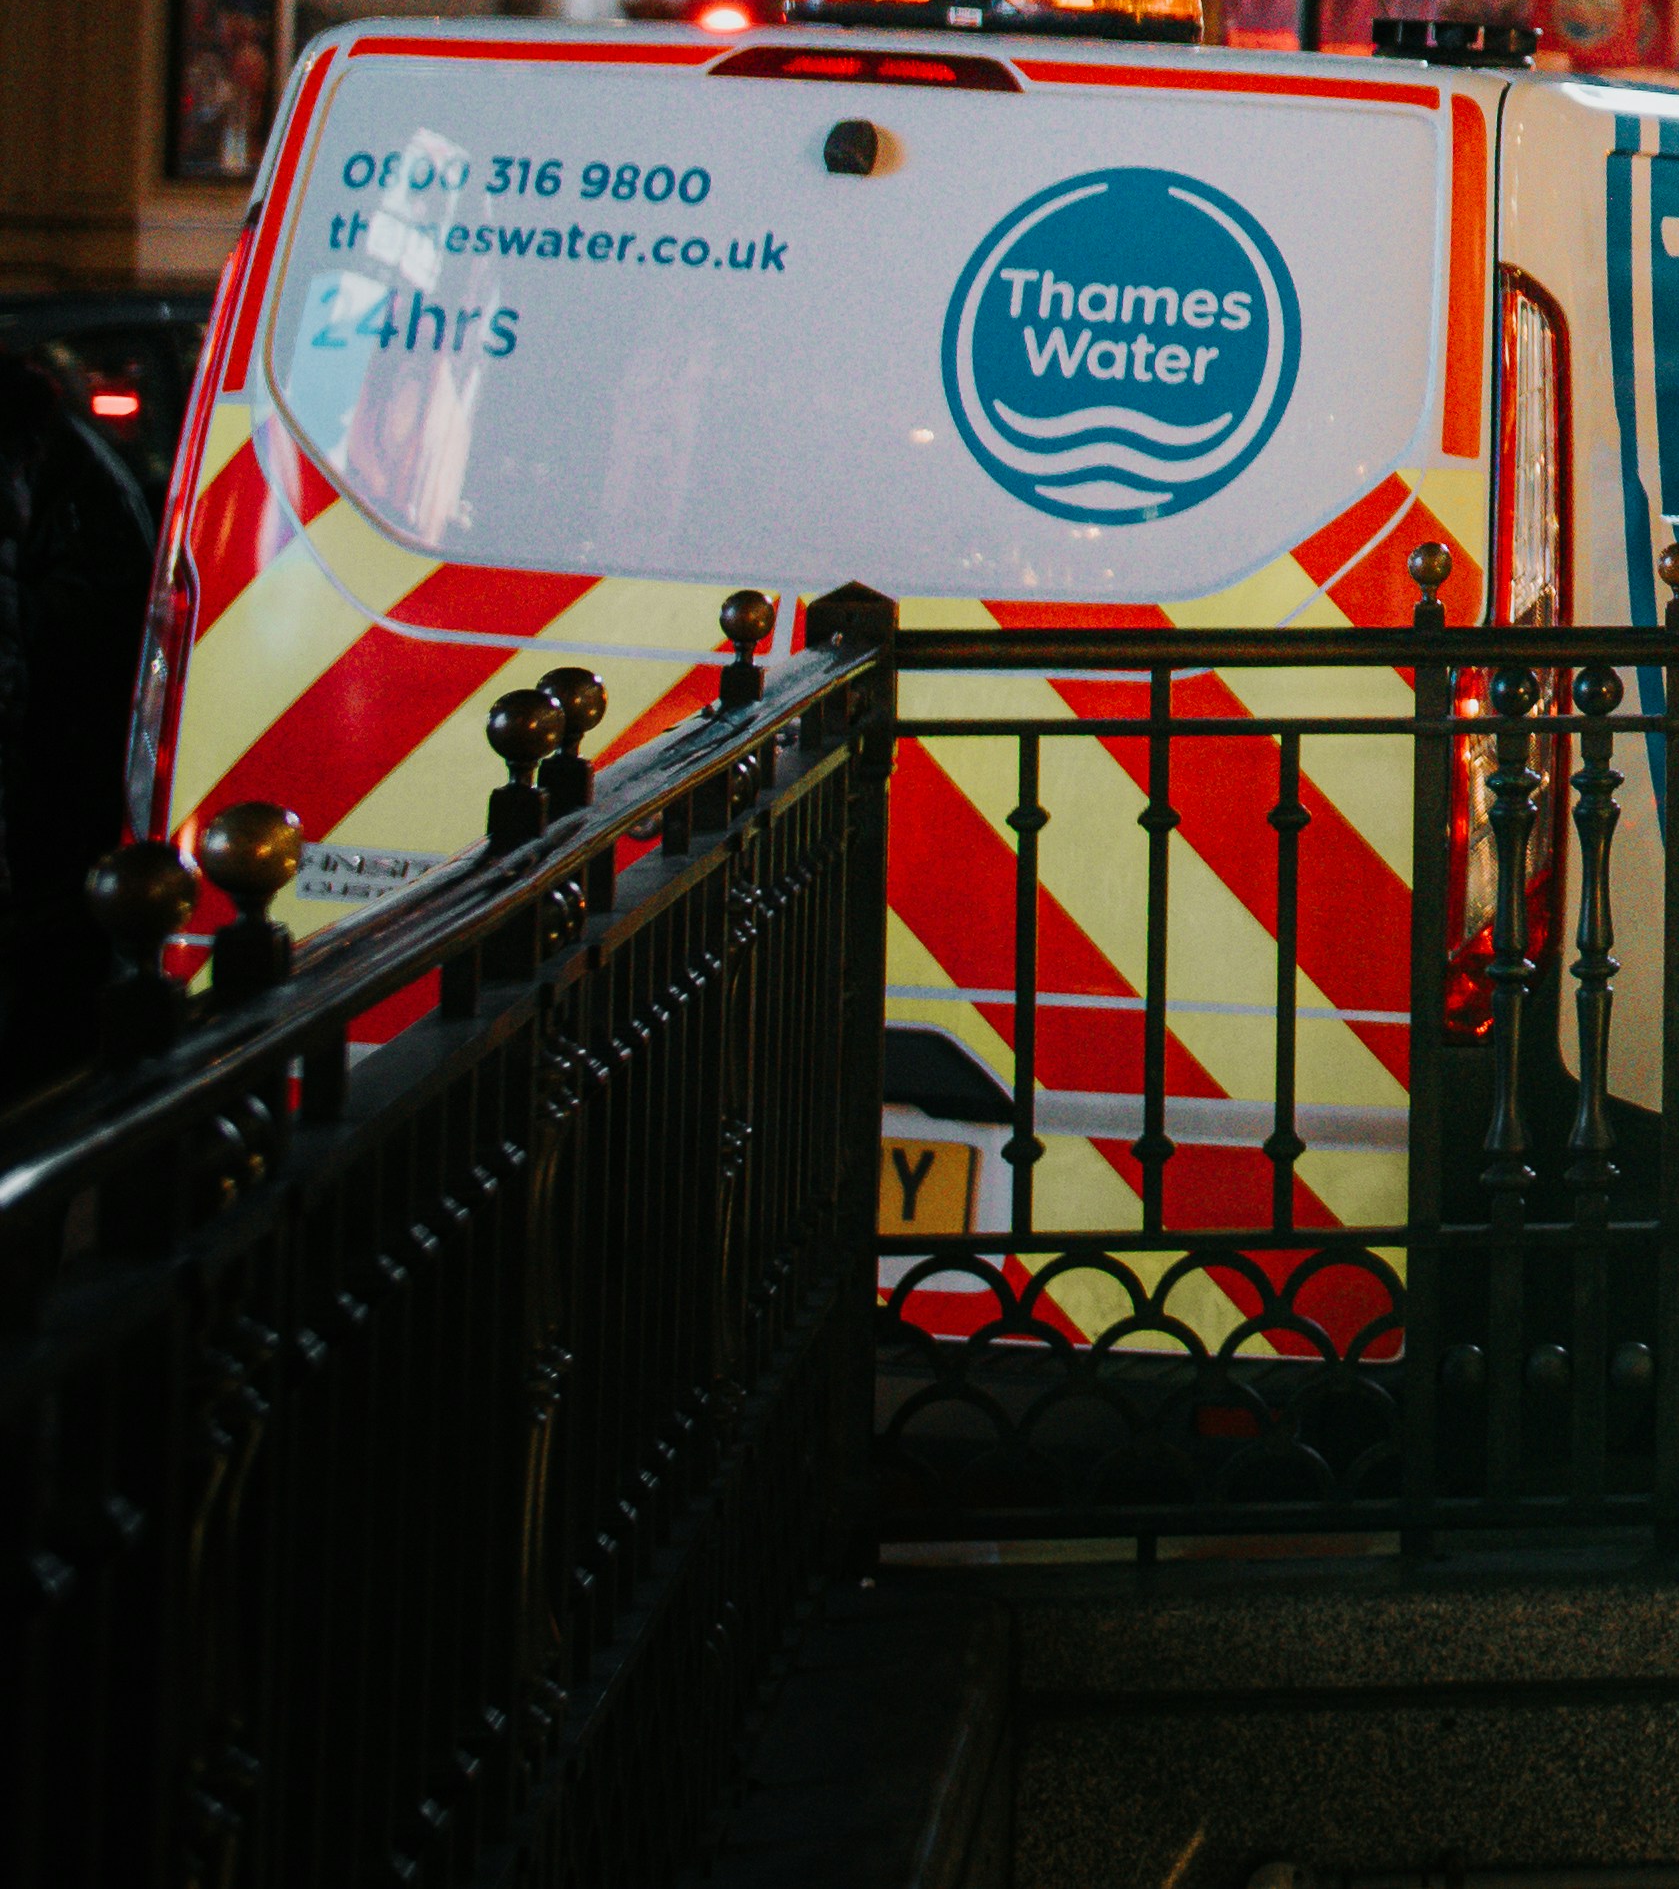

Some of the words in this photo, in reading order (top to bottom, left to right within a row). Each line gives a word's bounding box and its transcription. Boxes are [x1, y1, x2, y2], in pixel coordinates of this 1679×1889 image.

[342, 151, 470, 191] 0800
[486, 157, 562, 197] 316
[581, 162, 711, 205] 9800
[314, 290, 520, 359] 24hrs
[1001, 267, 1254, 332] Thames
[1024, 326, 1219, 384] Water
